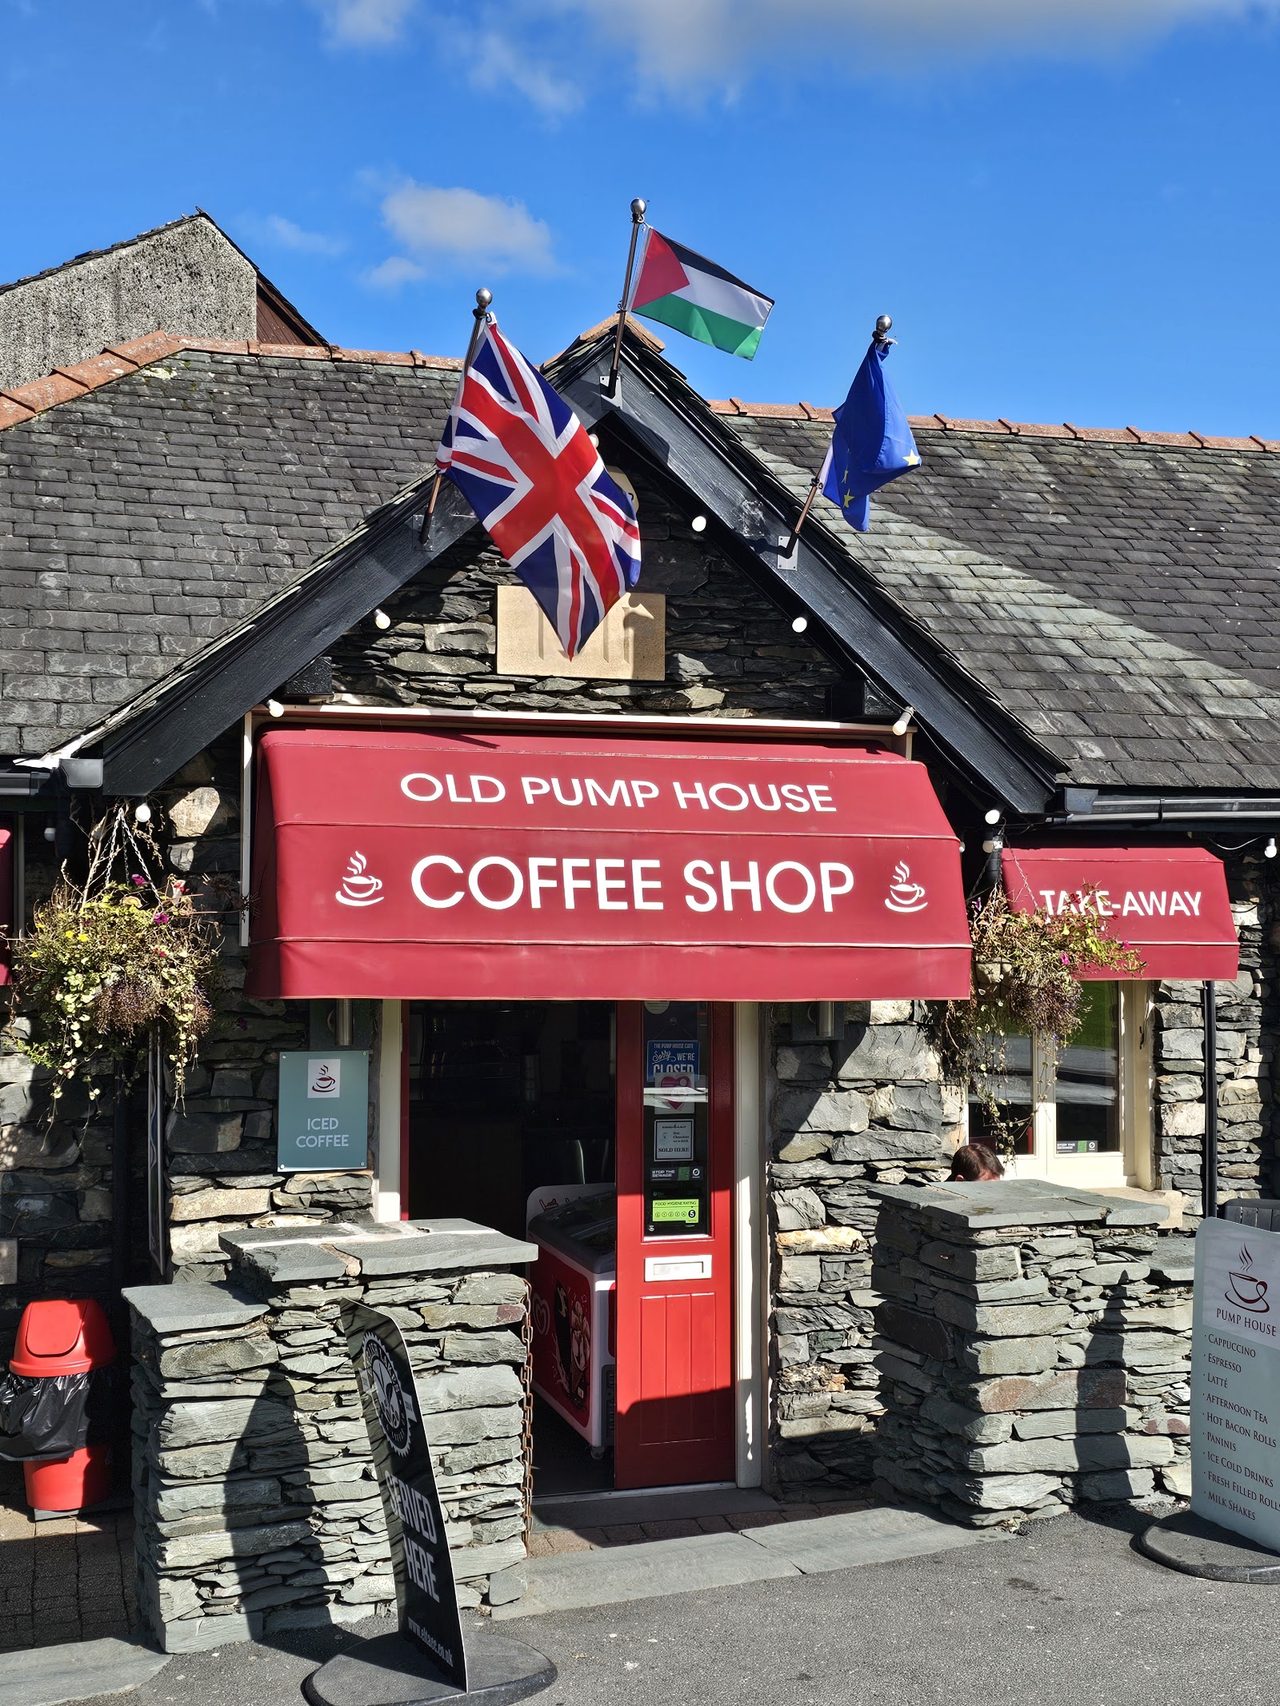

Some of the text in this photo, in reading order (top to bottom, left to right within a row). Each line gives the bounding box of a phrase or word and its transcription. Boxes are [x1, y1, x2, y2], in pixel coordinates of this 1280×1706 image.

[400, 772, 837, 813] OLD PUMP HOUSE
[410, 854, 855, 914] COFFEE SHOP
[1039, 890, 1202, 916] TAKE-AWAY
[676, 1052, 696, 1061] WE'RE
[307, 1118, 339, 1131] ICED
[296, 1134, 349, 1148] COFFEE
[1216, 1307, 1277, 1336] PUMP HOUSE
[1208, 1333, 1256, 1358] CAPPUCCINO
[1208, 1353, 1242, 1373] ESPRESSO
[1206, 1393, 1268, 1424] AFTERNOON TEA
[1207, 1411, 1277, 1448] HOT BACON ROLLS
[1207, 1431, 1237, 1452] PANINIS
[1207, 1451, 1274, 1488] ICE COLD DRINKS
[1208, 1471, 1230, 1489] FRESH
[1232, 1481, 1257, 1501] FILLED
[384, 1470, 438, 1545] SERVED
[1208, 1491, 1256, 1521] MILK SHAKES
[402, 1533, 440, 1603] HERE
